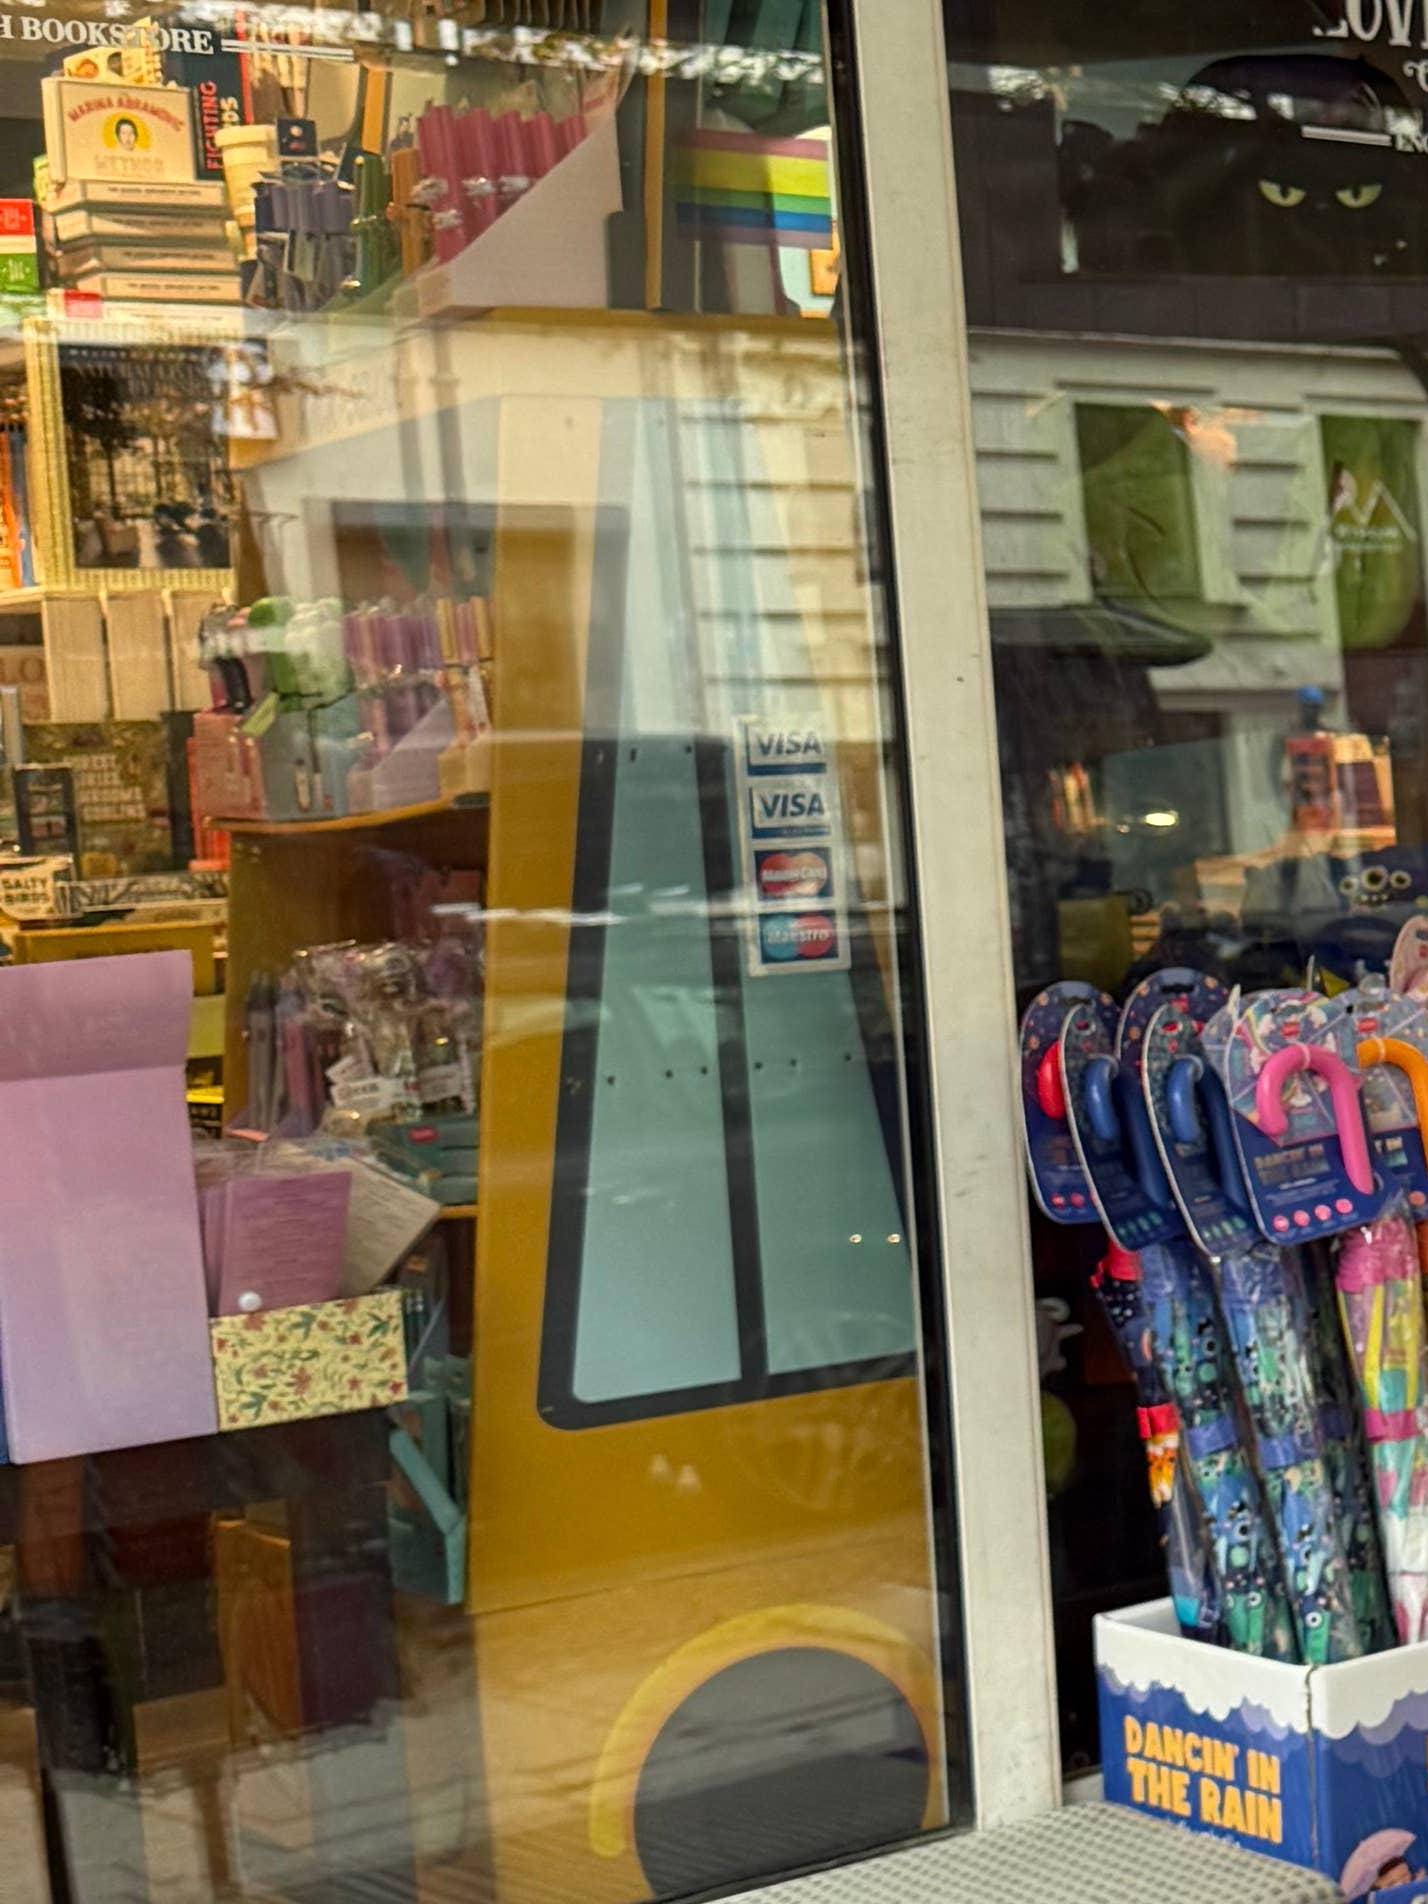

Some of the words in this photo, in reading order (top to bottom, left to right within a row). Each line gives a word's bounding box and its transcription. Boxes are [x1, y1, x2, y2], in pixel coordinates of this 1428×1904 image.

[20, 15, 214, 56] BOOKSTORE
[200, 80, 219, 170] FIGHTING
[757, 732, 822, 756] VISA
[760, 792, 825, 818] VISA
[1124, 1715, 1240, 1773] DANCIN'
[1246, 1748, 1281, 1793] IN
[1126, 1756, 1192, 1819] THE
[1199, 1788, 1283, 1845] RAIN
